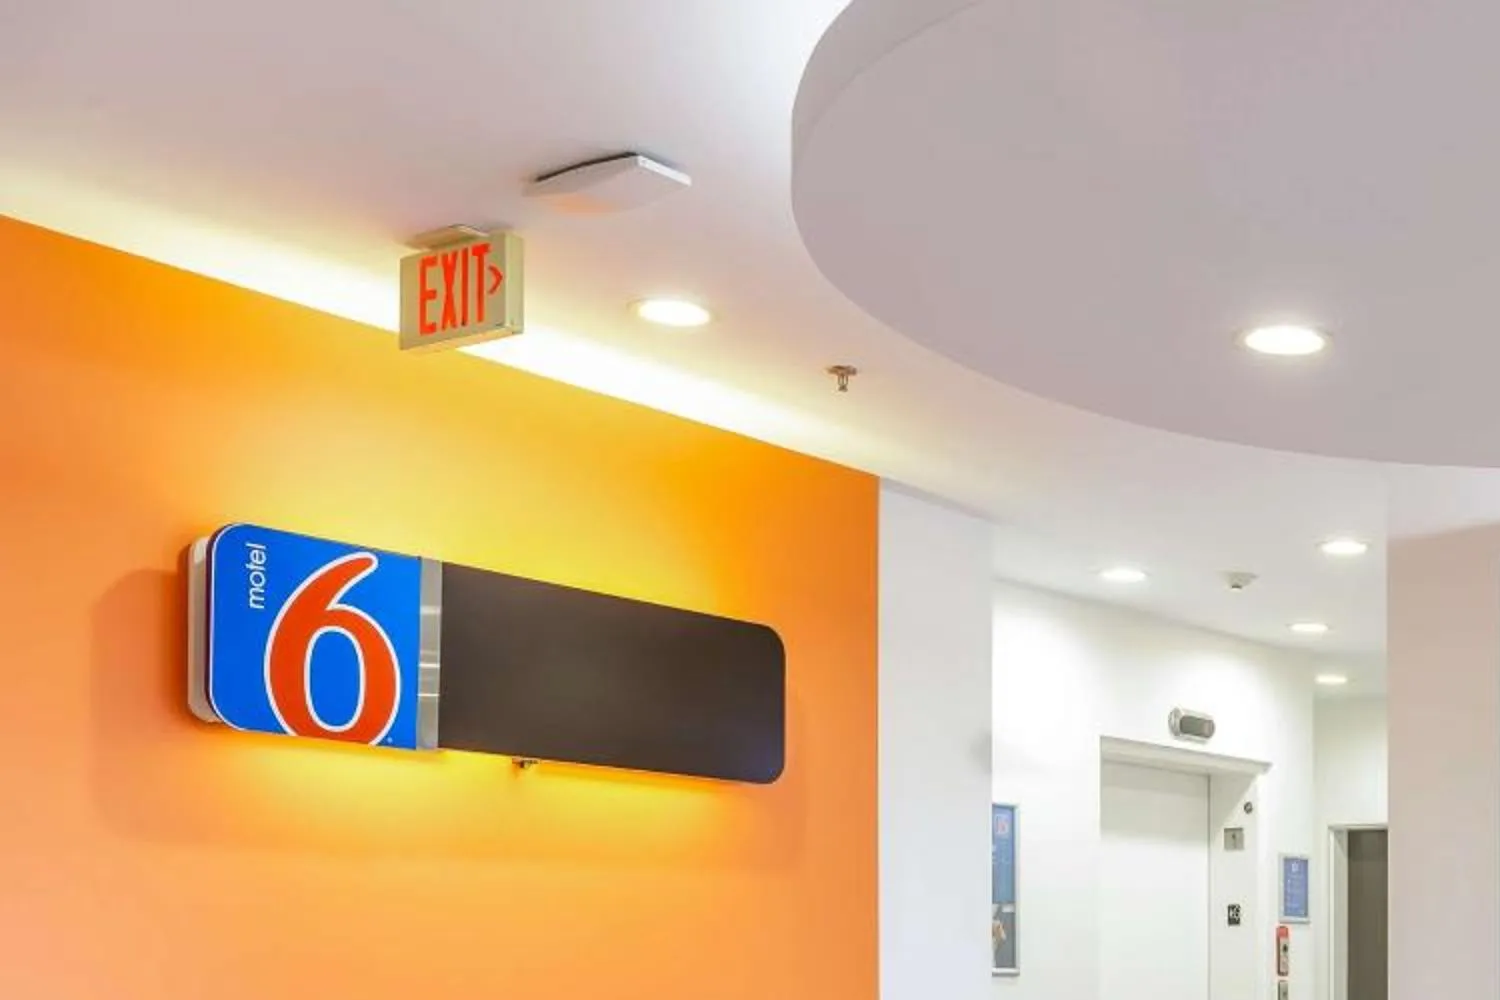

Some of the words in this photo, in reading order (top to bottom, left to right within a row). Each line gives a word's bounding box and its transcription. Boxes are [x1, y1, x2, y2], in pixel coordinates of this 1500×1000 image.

[419, 242, 491, 336] EXIT
[245, 542, 267, 609] motel
[264, 552, 400, 746] 6
